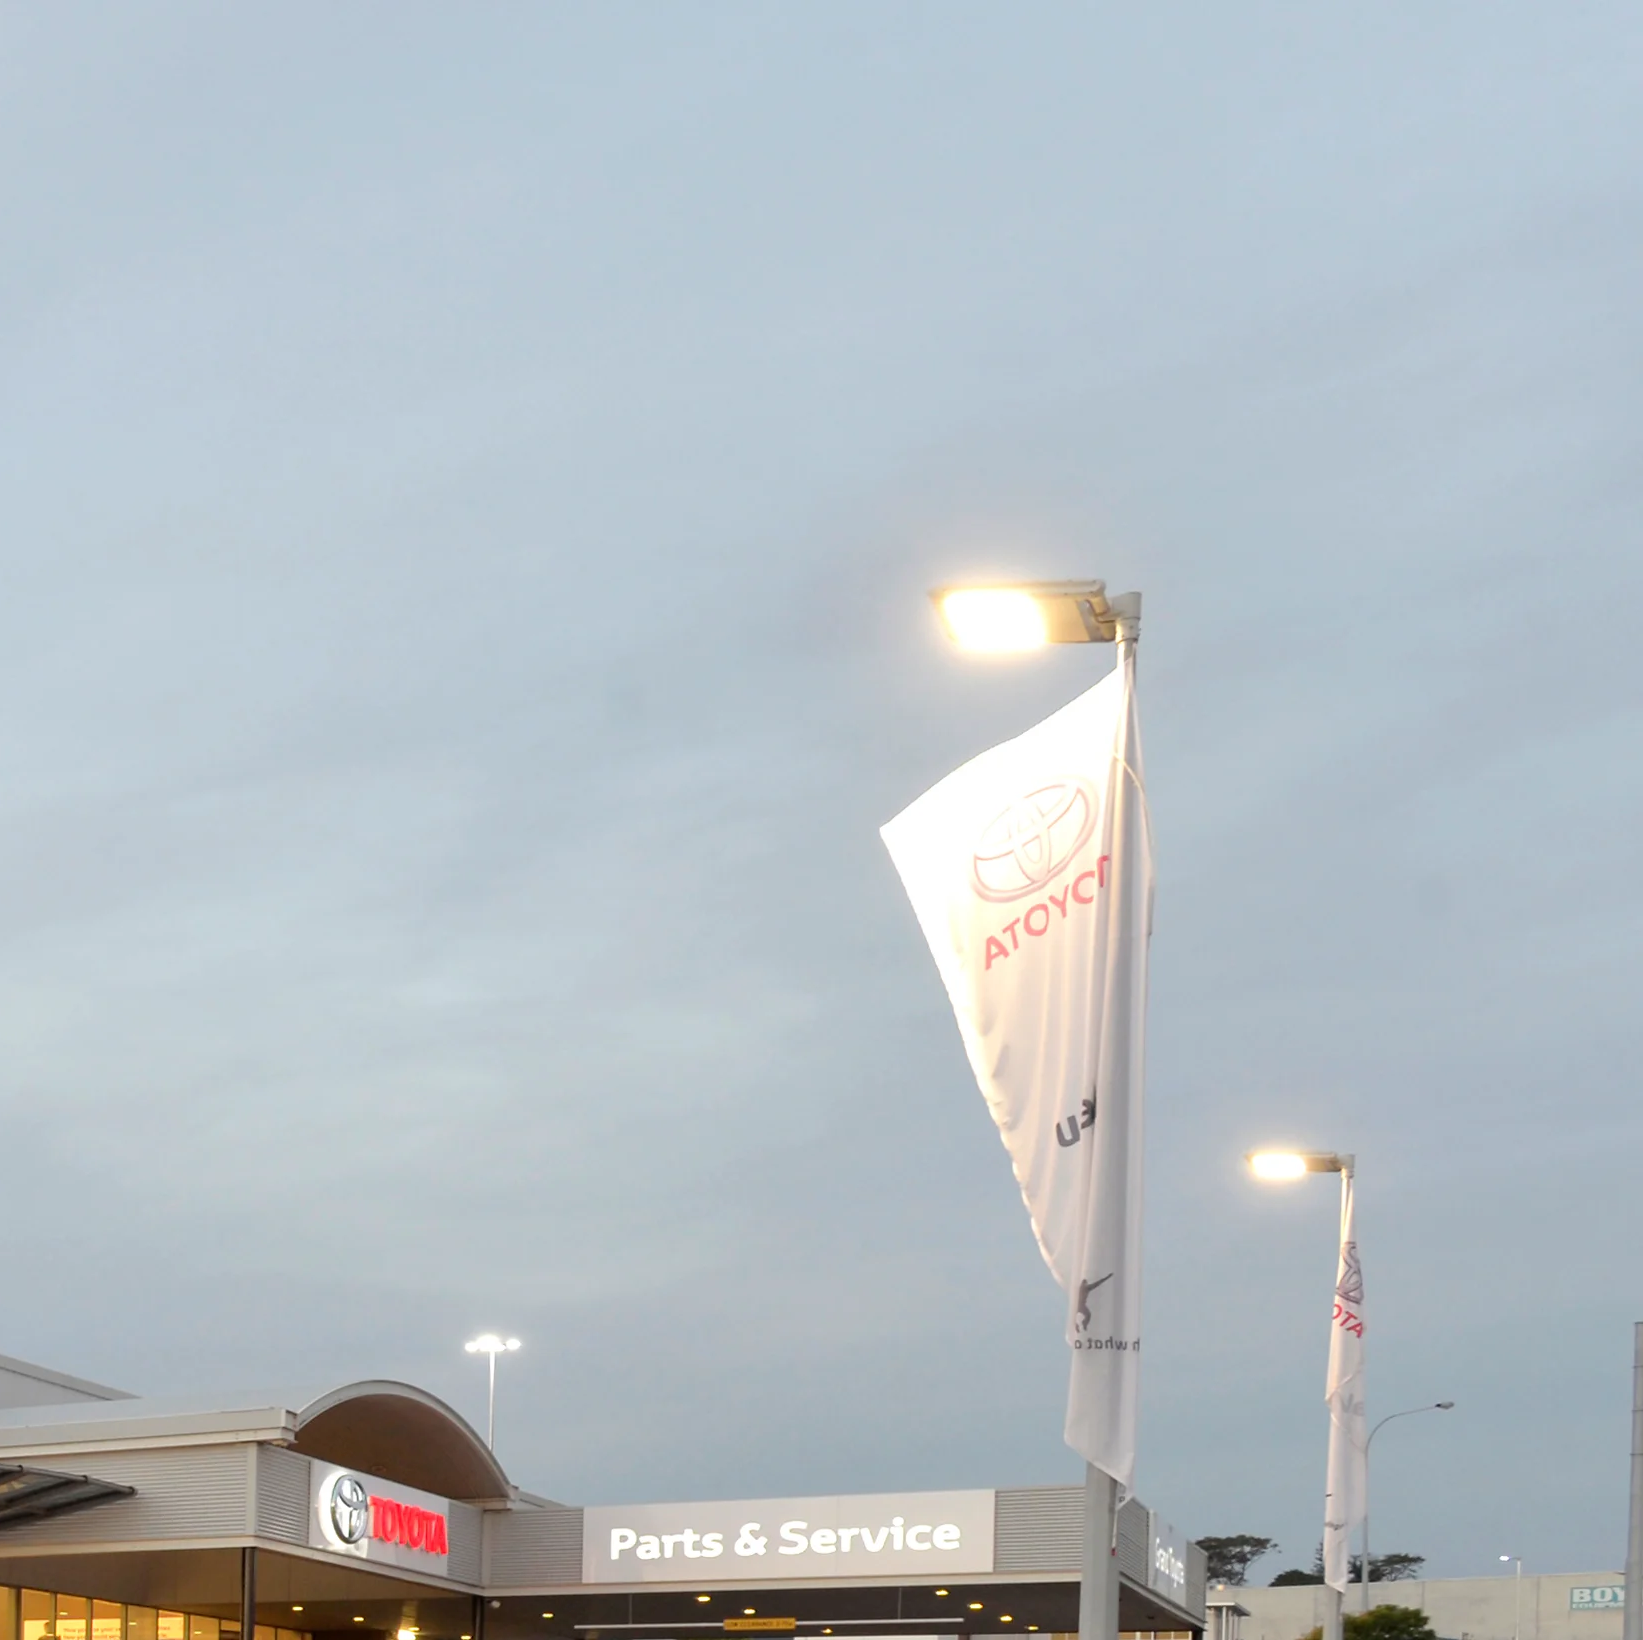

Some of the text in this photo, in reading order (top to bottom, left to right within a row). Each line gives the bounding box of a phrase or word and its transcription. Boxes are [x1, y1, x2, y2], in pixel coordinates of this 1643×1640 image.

[1332, 1303, 1365, 1339] OTA
[368, 1494, 449, 1556] TOYOTA
[610, 1516, 961, 1560] Parts & Service
[1572, 1587, 1625, 1603] BOY
